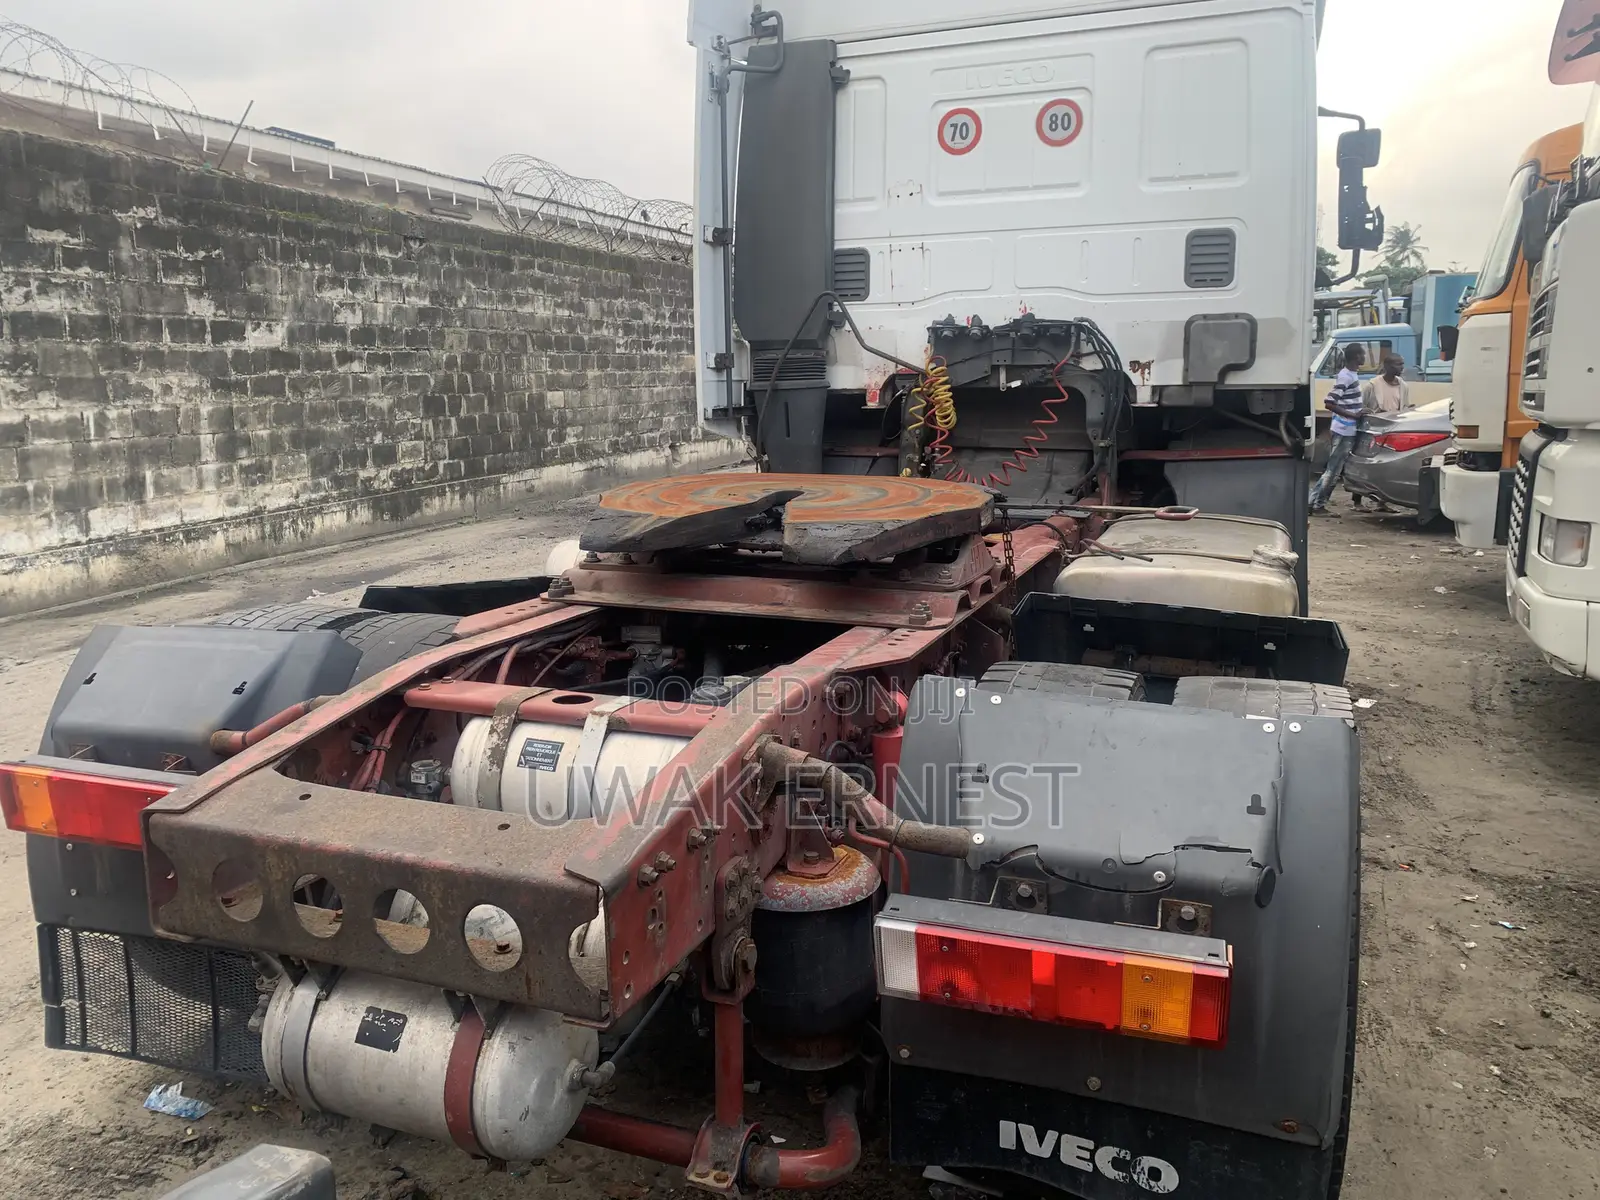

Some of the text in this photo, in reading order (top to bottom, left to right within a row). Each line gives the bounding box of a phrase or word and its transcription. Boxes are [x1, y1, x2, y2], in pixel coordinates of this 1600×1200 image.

[965, 65, 1055, 90] IVECO
[950, 121, 970, 142] 70
[1048, 112, 1072, 132] 80
[999, 1119, 1180, 1194] IVECO
